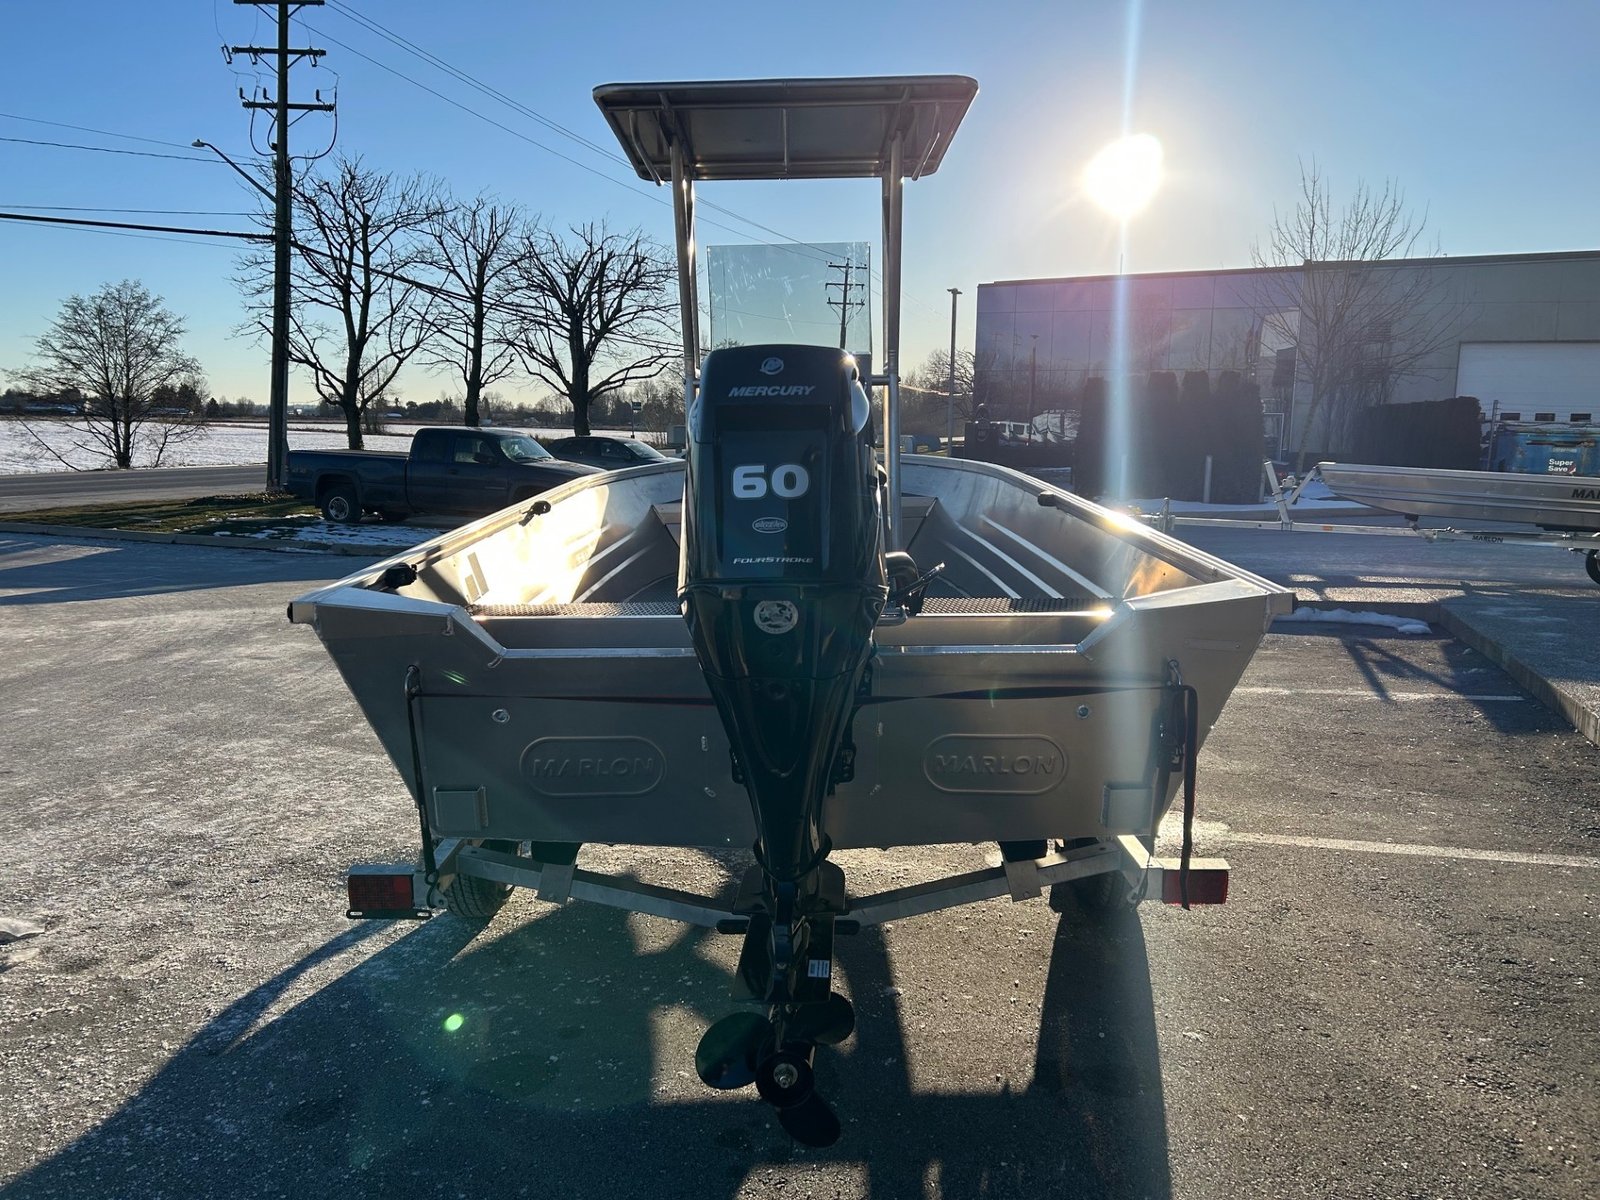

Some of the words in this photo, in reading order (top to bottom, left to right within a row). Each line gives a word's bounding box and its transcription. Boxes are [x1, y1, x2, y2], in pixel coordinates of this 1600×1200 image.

[728, 385, 816, 398] MERCURY
[1549, 458, 1574, 467] Super
[732, 464, 810, 498] 60
[733, 556, 814, 565] FOURSTROKE
[531, 757, 654, 777] MARLON
[935, 754, 1056, 775] MARLON
